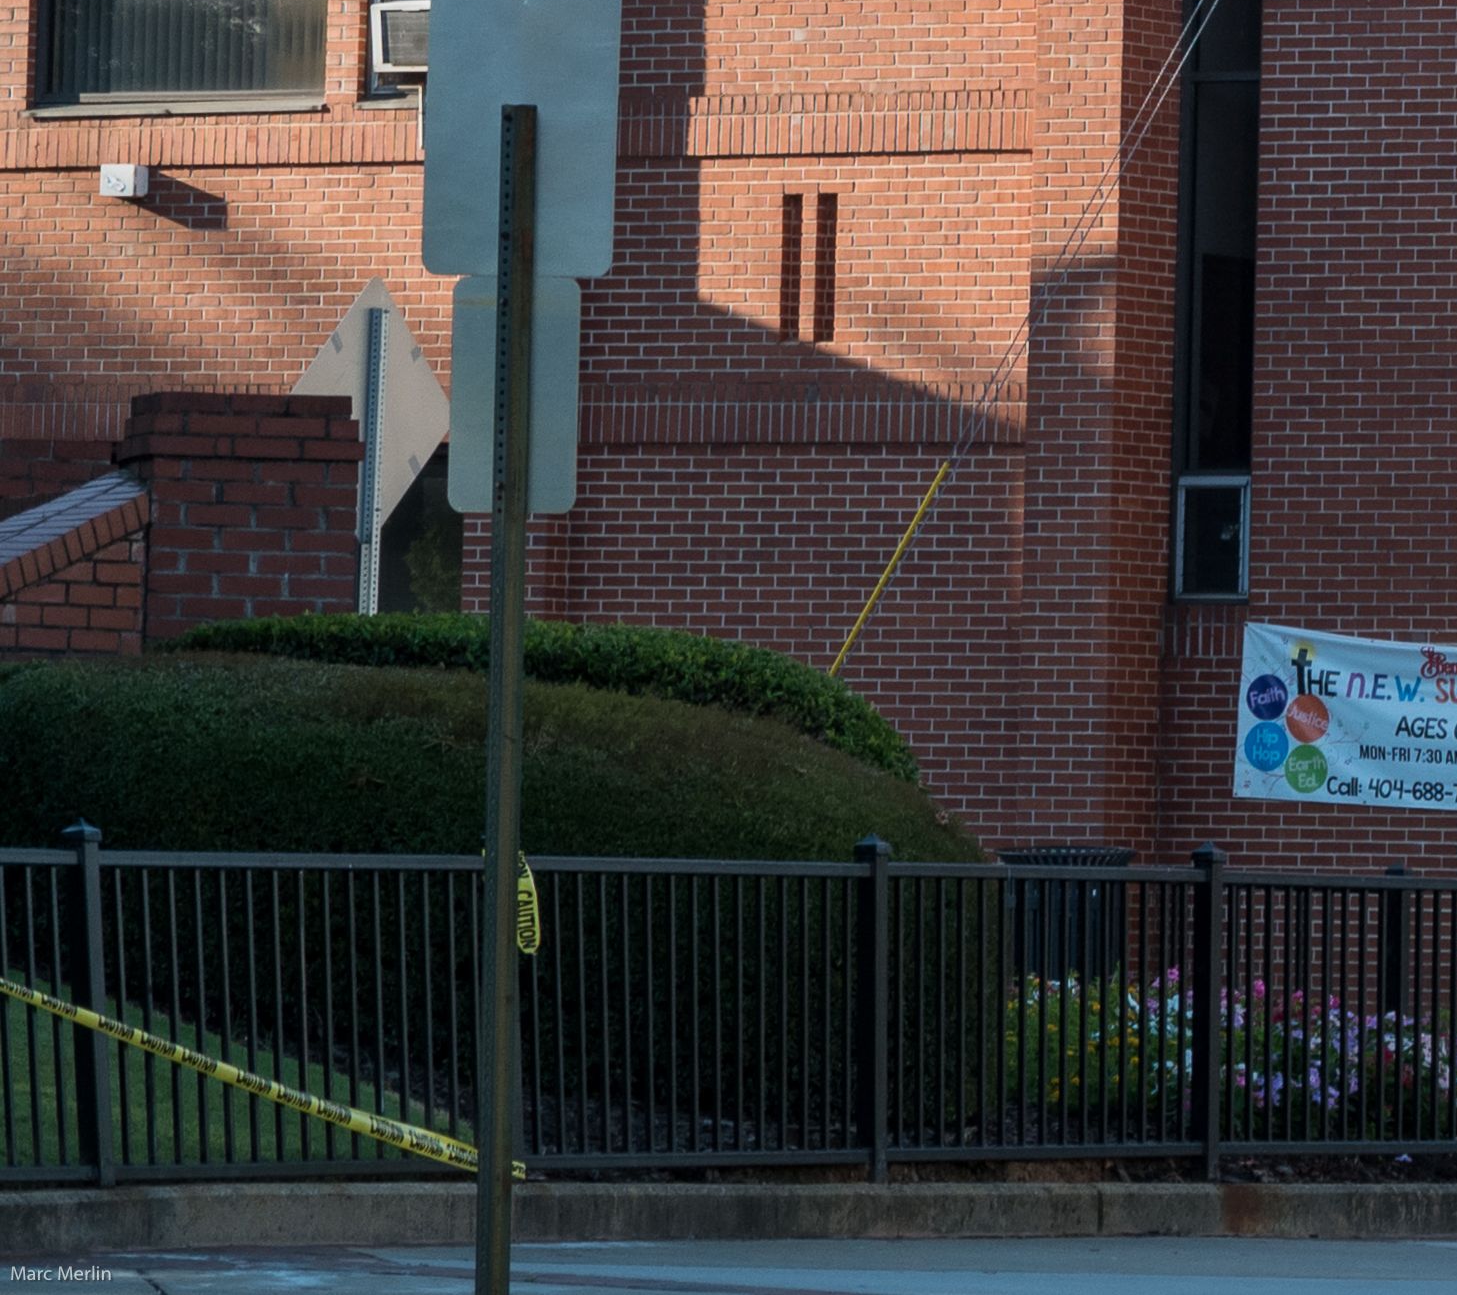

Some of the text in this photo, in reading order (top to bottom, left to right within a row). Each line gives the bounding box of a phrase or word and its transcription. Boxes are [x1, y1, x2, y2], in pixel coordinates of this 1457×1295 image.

[1249, 687, 1285, 709] Faith
[1288, 704, 1330, 731] Justice
[1395, 716, 1448, 740] AGES
[1256, 728, 1279, 747] Hip
[1252, 745, 1280, 765] Hop
[1289, 756, 1328, 771] Earth
[1358, 745, 1411, 764] MON-FRI
[1414, 747, 1442, 765] 7:30
[1327, 775, 1363, 798] Call:
[517, 890, 536, 949] CAUTION
